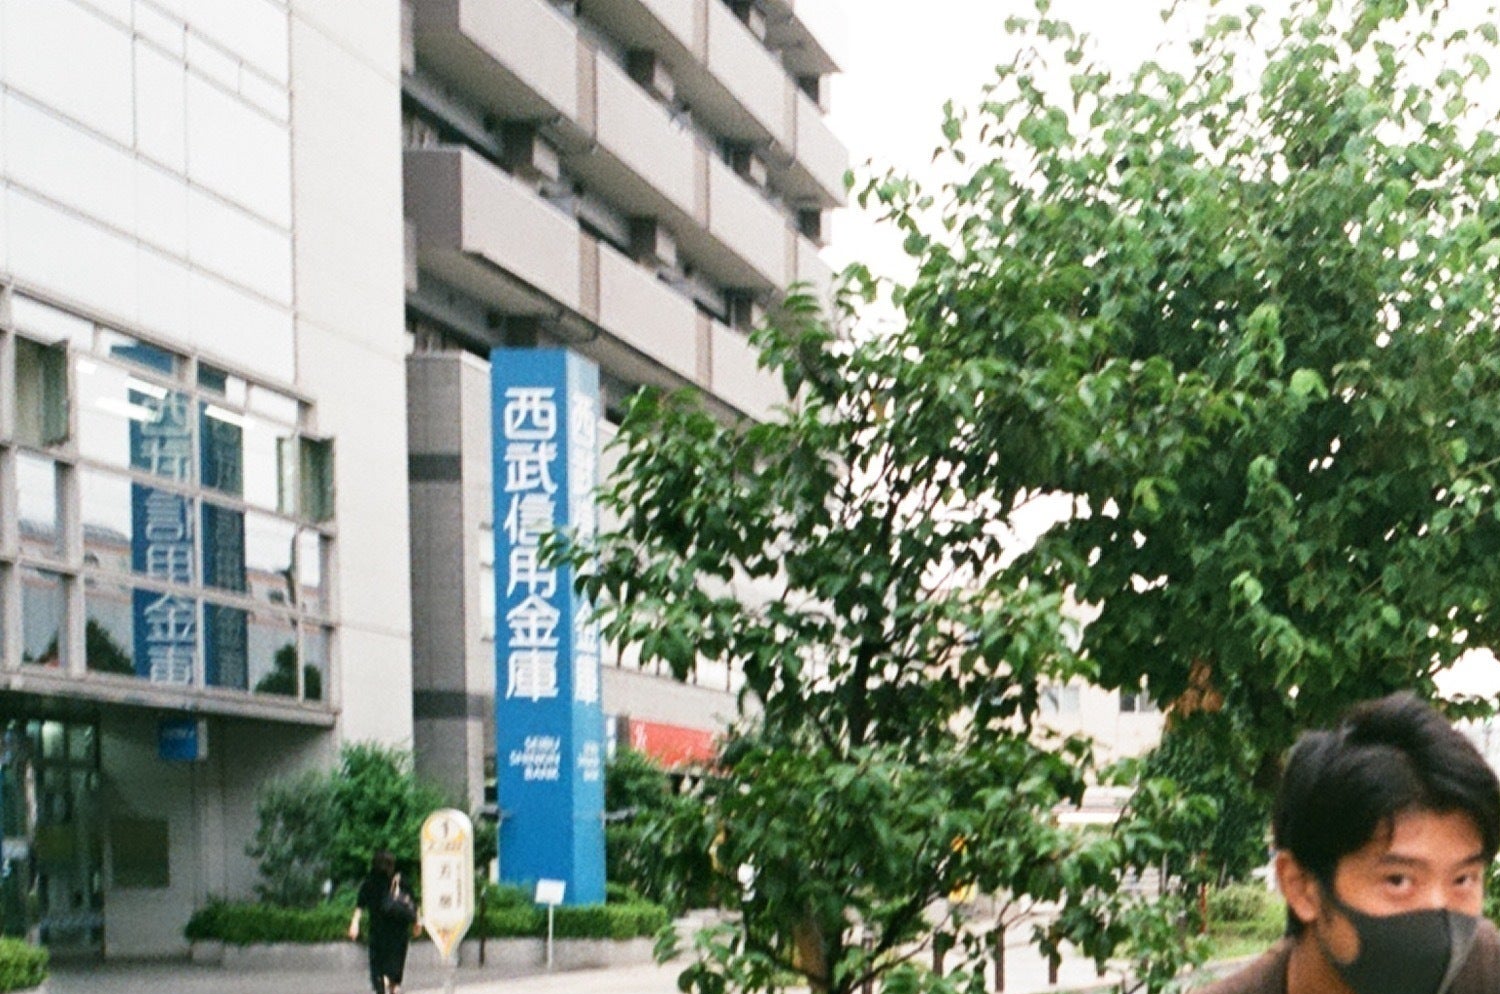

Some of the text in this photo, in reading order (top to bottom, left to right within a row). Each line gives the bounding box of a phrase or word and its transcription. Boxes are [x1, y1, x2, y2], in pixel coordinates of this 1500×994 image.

[504, 387, 559, 702] 西武信用金庫
[523, 767, 561, 782] BANK
